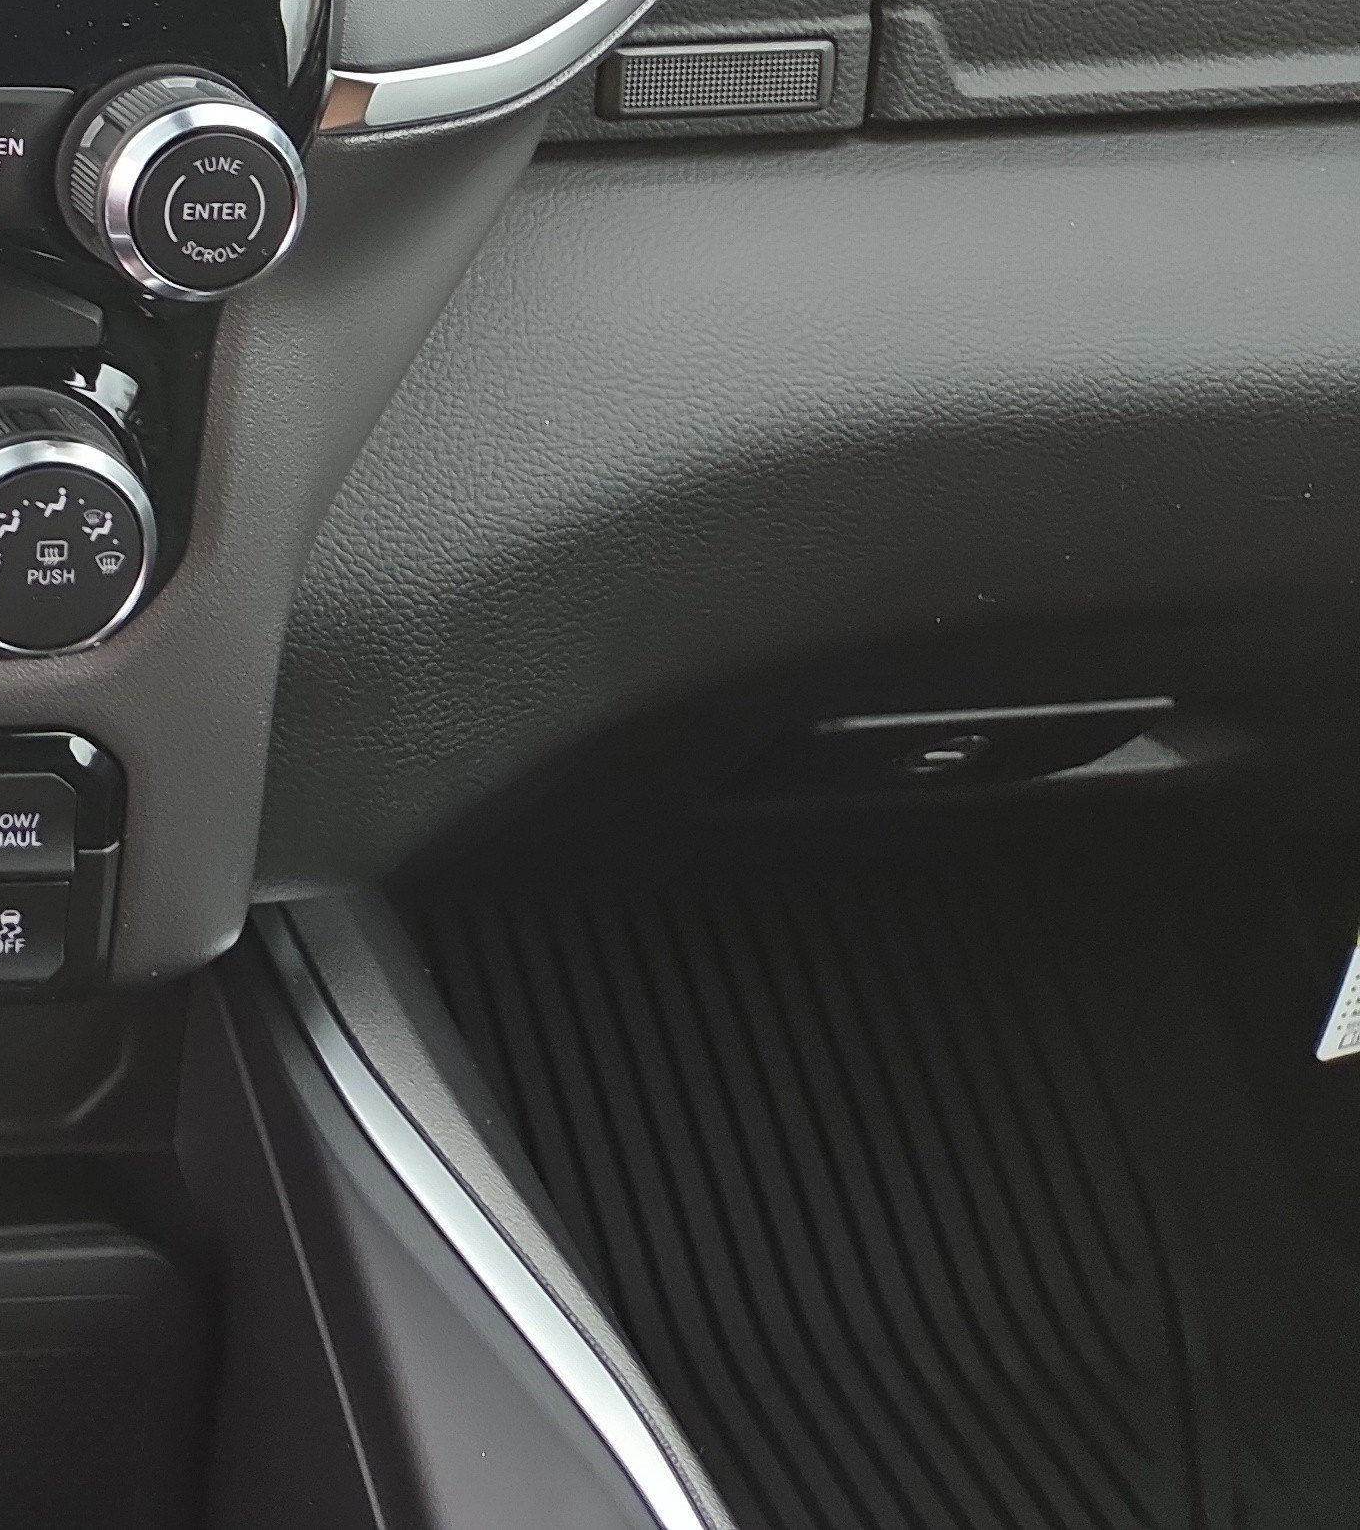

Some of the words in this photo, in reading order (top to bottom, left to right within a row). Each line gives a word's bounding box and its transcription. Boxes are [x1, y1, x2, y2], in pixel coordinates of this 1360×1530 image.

[193, 156, 244, 177] TUNE
[182, 201, 247, 221] ENTER
[181, 239, 247, 264] SCROLL
[27, 566, 75, 586] PUSH
